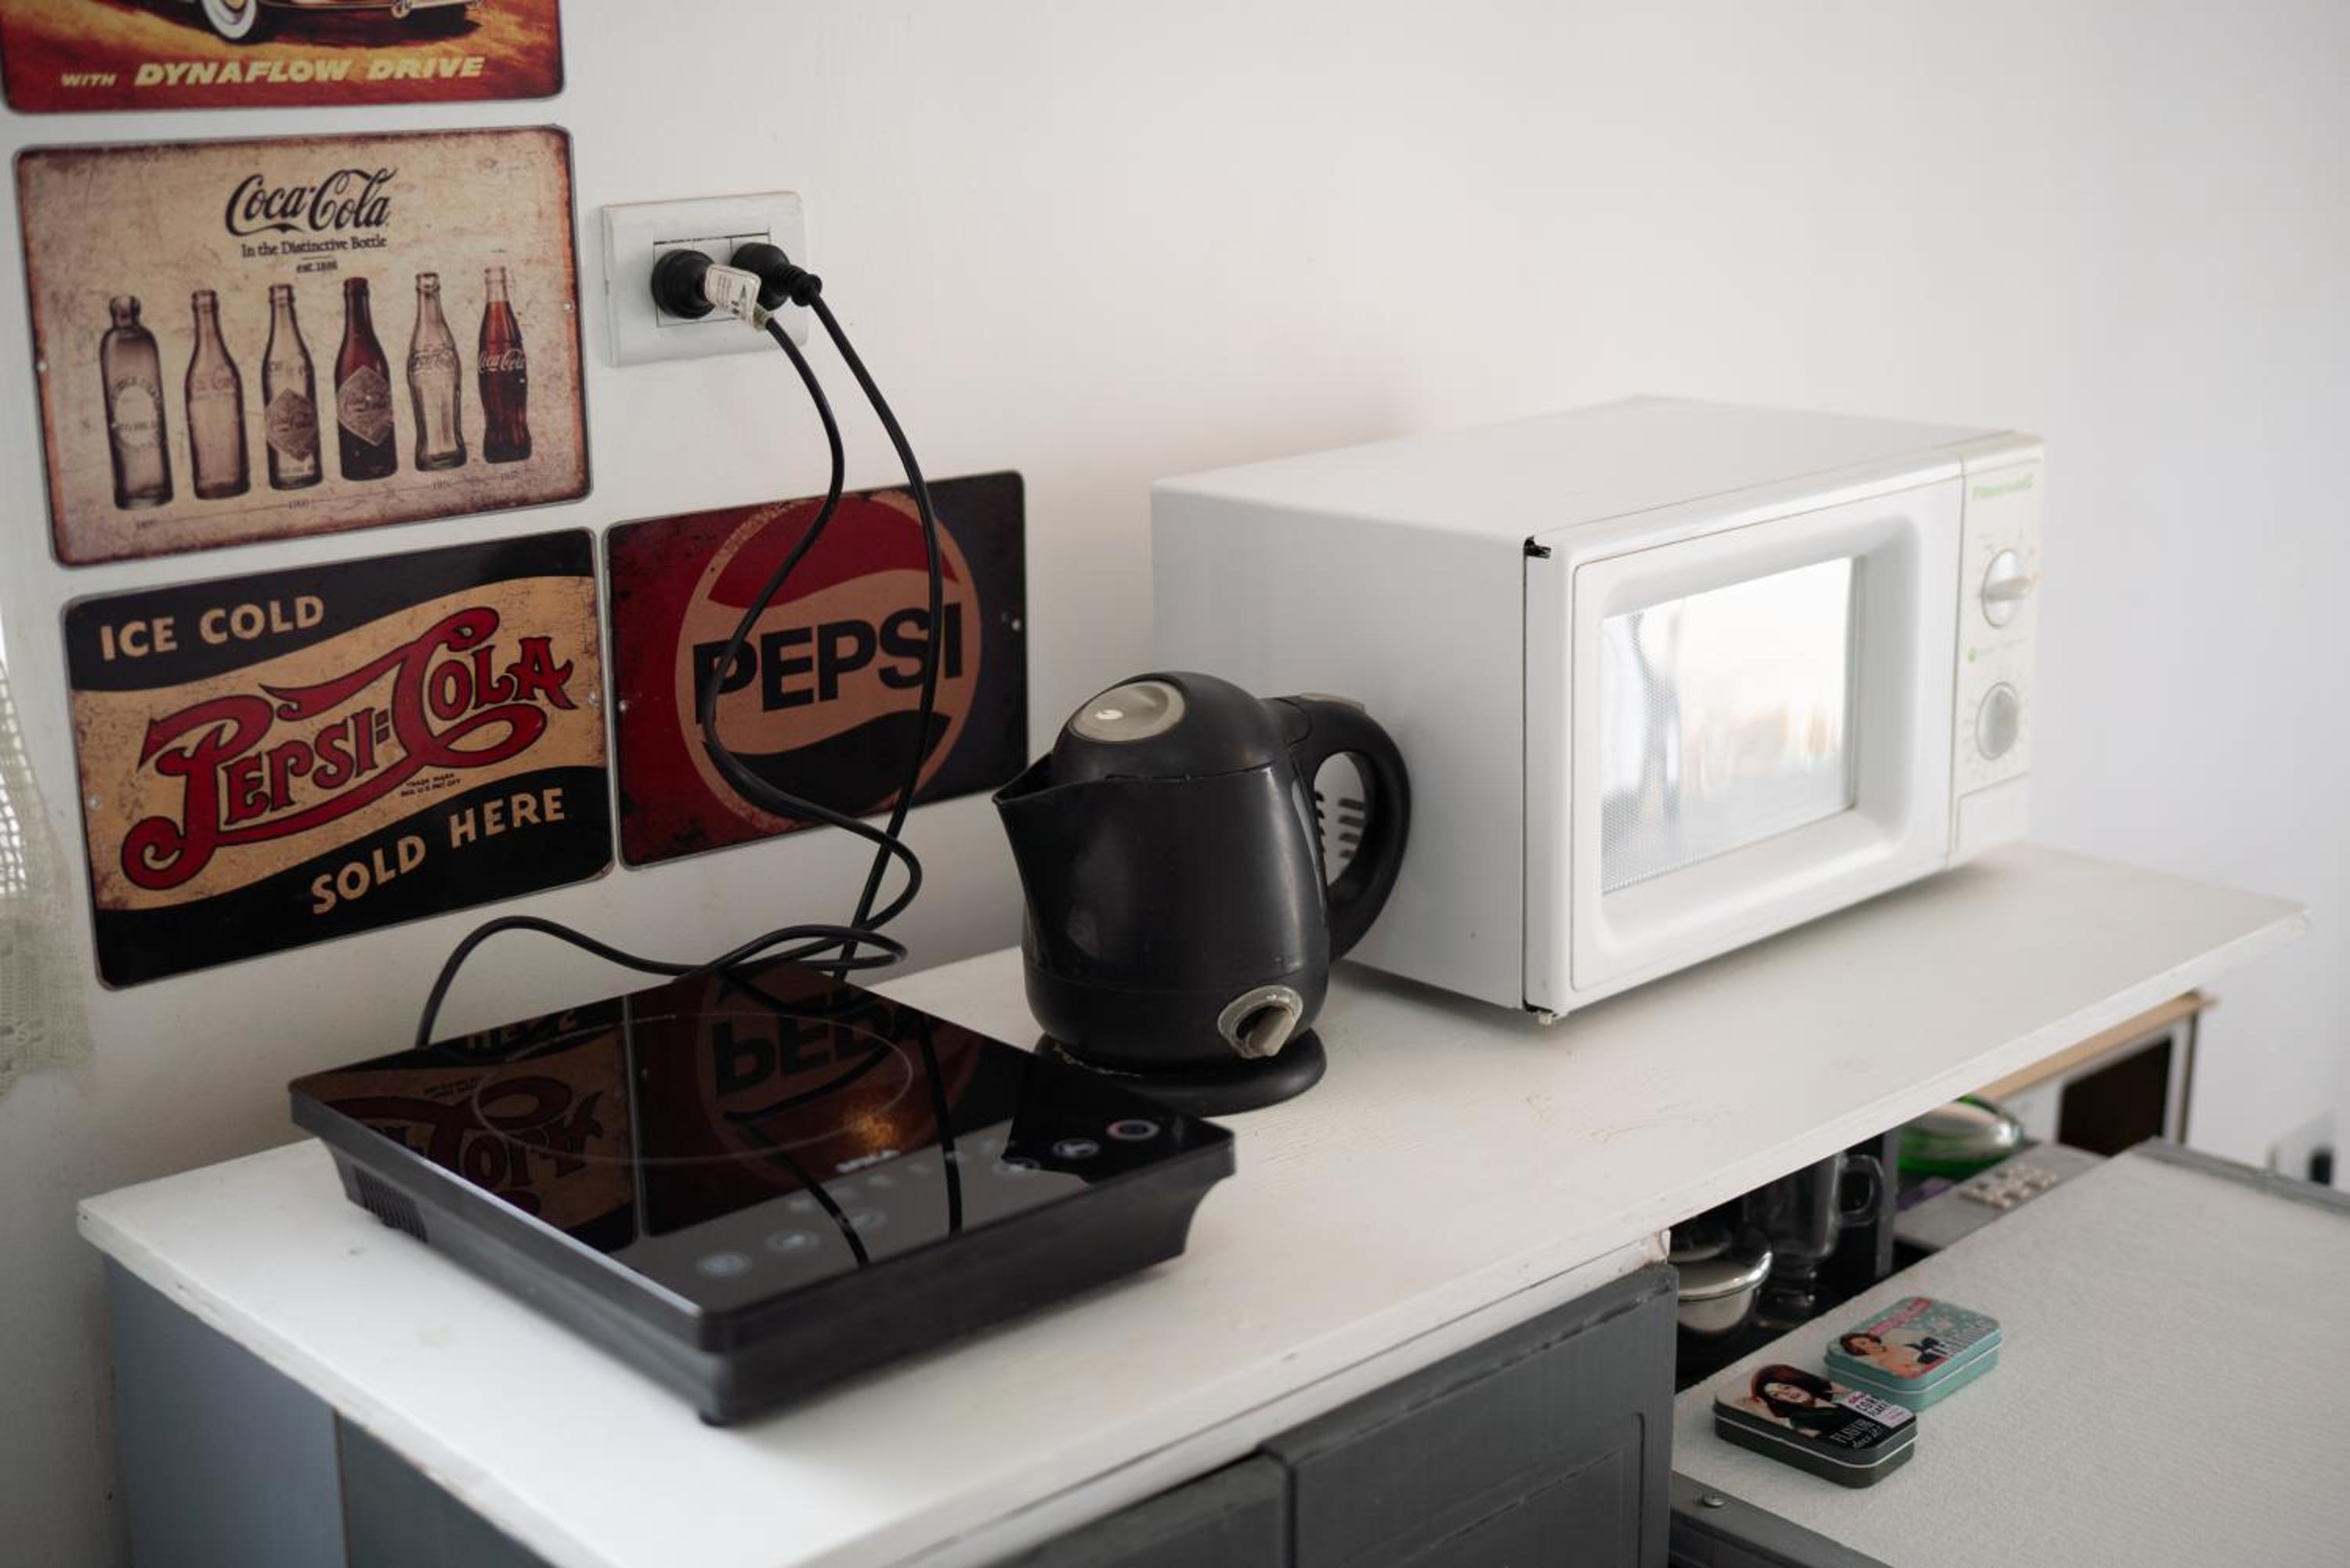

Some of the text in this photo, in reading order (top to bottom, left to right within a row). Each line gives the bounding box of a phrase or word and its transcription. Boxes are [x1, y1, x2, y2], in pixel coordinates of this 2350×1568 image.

[61, 56, 486, 87] WITH DYNAFLOW DRIVE
[225, 167, 398, 237] Coca-Cola
[241, 235, 388, 258] In the Distinctive Bottle
[100, 594, 324, 661] ICE COLD
[692, 602, 963, 725] PEPSI
[310, 787, 565, 915] SOLD HERE
